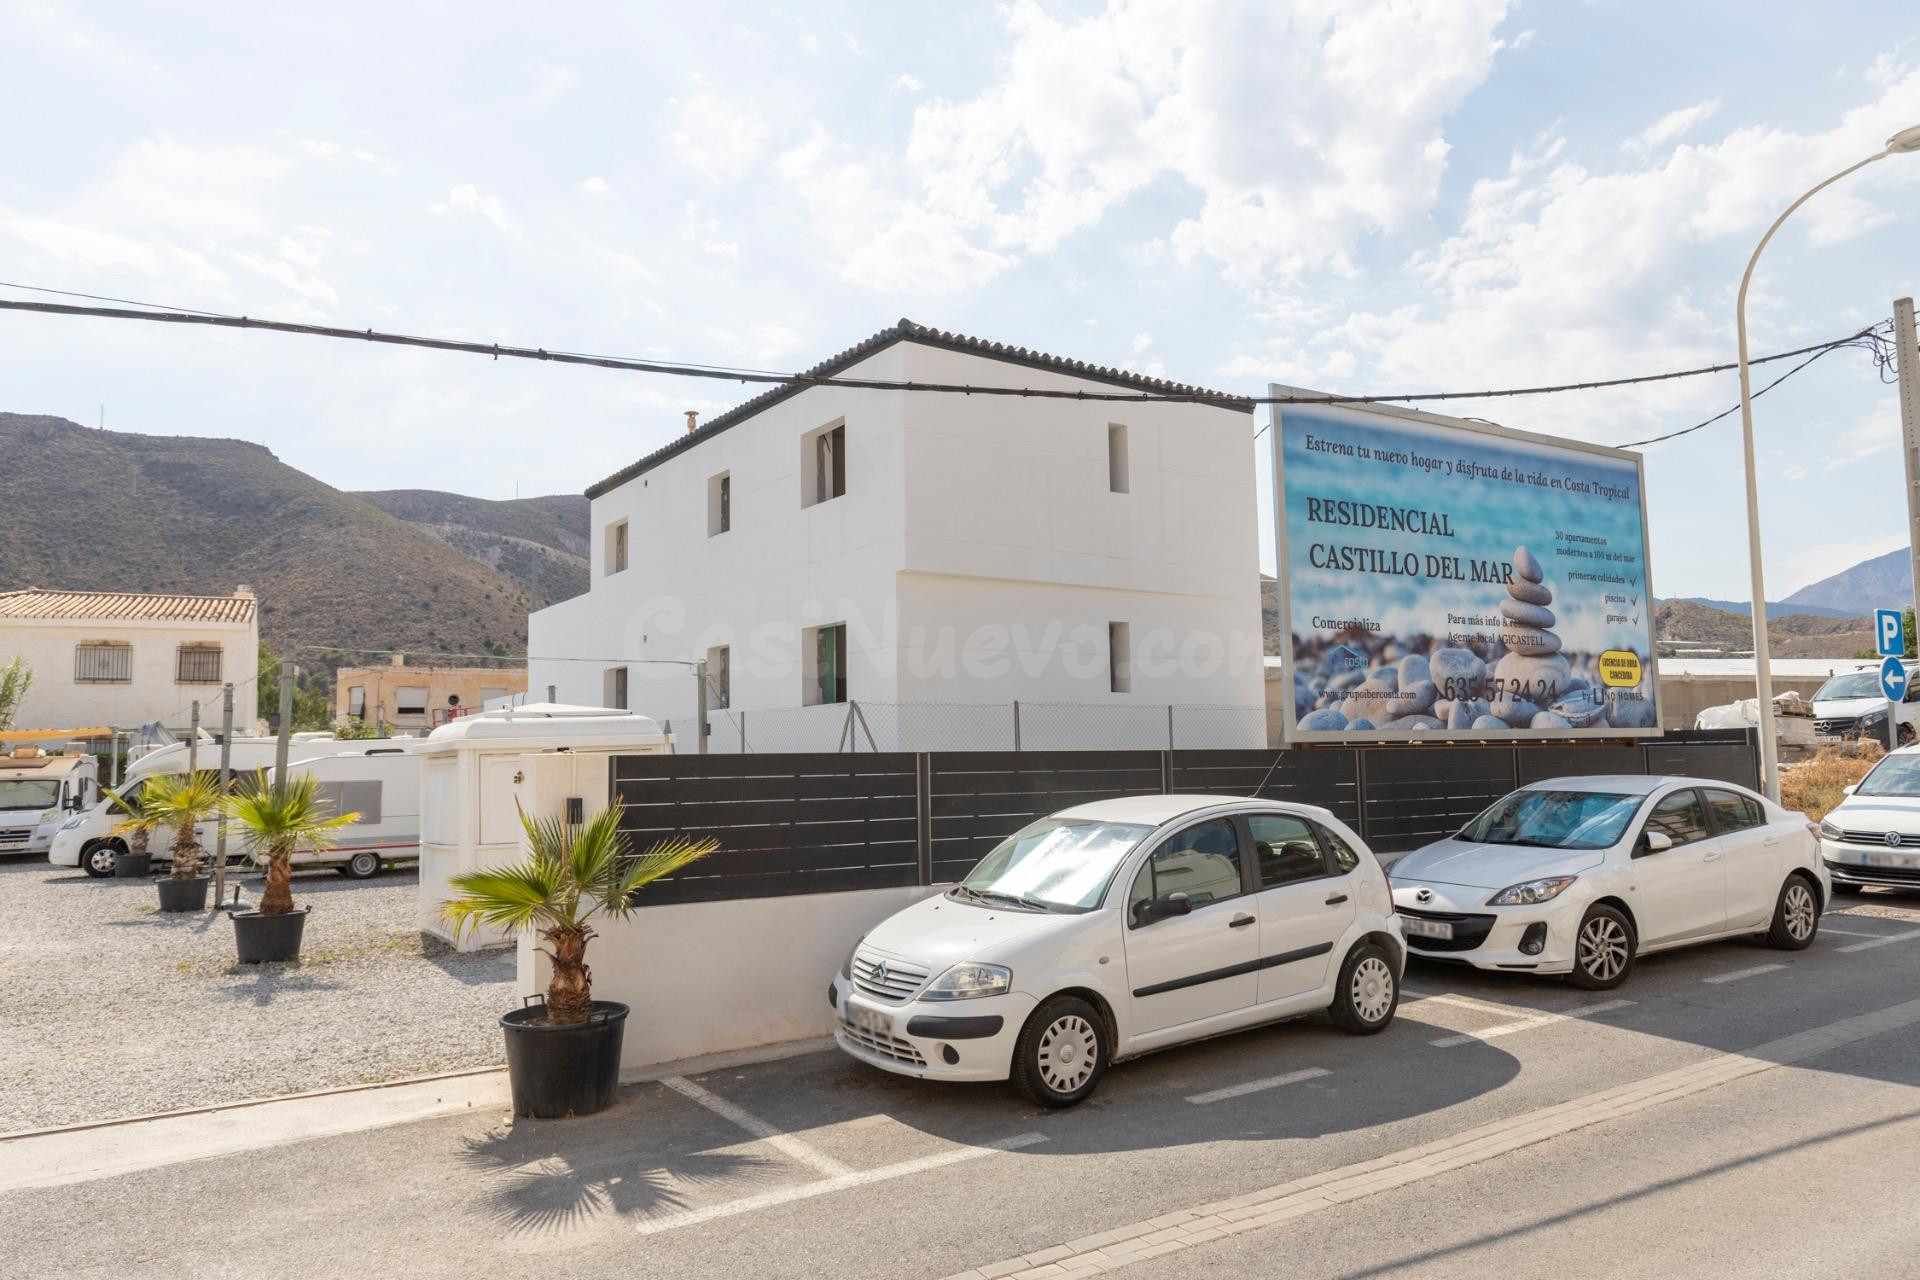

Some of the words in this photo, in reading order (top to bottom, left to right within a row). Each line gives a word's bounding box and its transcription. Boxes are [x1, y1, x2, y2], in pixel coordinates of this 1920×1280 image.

[1306, 435, 1353, 456] Estrena
[1358, 445, 1370, 458] tu
[1374, 450, 1408, 464] nuevo
[1411, 452, 1443, 472] hogar
[1446, 461, 1452, 475] y
[1456, 459, 1498, 480] disfruta
[1501, 467, 1512, 481] de
[1516, 469, 1524, 483] la
[1528, 472, 1548, 487] vida
[1551, 479, 1562, 488] en
[1564, 478, 1590, 494] Costa
[1592, 482, 1630, 500] Tropical
[1307, 497, 1454, 537] RESIDENCIAL
[1565, 534, 1607, 545] apartamentos
[1556, 547, 1588, 558] modernos
[1613, 552, 1622, 562] del
[1310, 543, 1419, 576] CASTILLO
[1425, 555, 1465, 580] DEL
[1470, 559, 1514, 585] MAR
[1568, 570, 1596, 581] primeras
[1597, 571, 1625, 584] calidades
[1605, 593, 1626, 604] piscina
[1312, 615, 1381, 631] Comercializa
[1447, 613, 1466, 624] Para
[1468, 614, 1483, 625] más
[1485, 616, 1500, 626] info
[1502, 618, 1508, 627] &
[1606, 613, 1627, 624] garajes
[1447, 632, 1476, 645] Agente
[1477, 632, 1495, 644] local
[1882, 614, 1898, 650] P
[1318, 689, 1416, 702] www.grupoibercosta.com
[1445, 677, 1478, 701] 635
[1485, 679, 1505, 702] 57
[1511, 679, 1531, 702] 24
[1538, 679, 1557, 702] 24
[1582, 692, 1591, 703] by
[1618, 692, 1644, 701] HOMES
